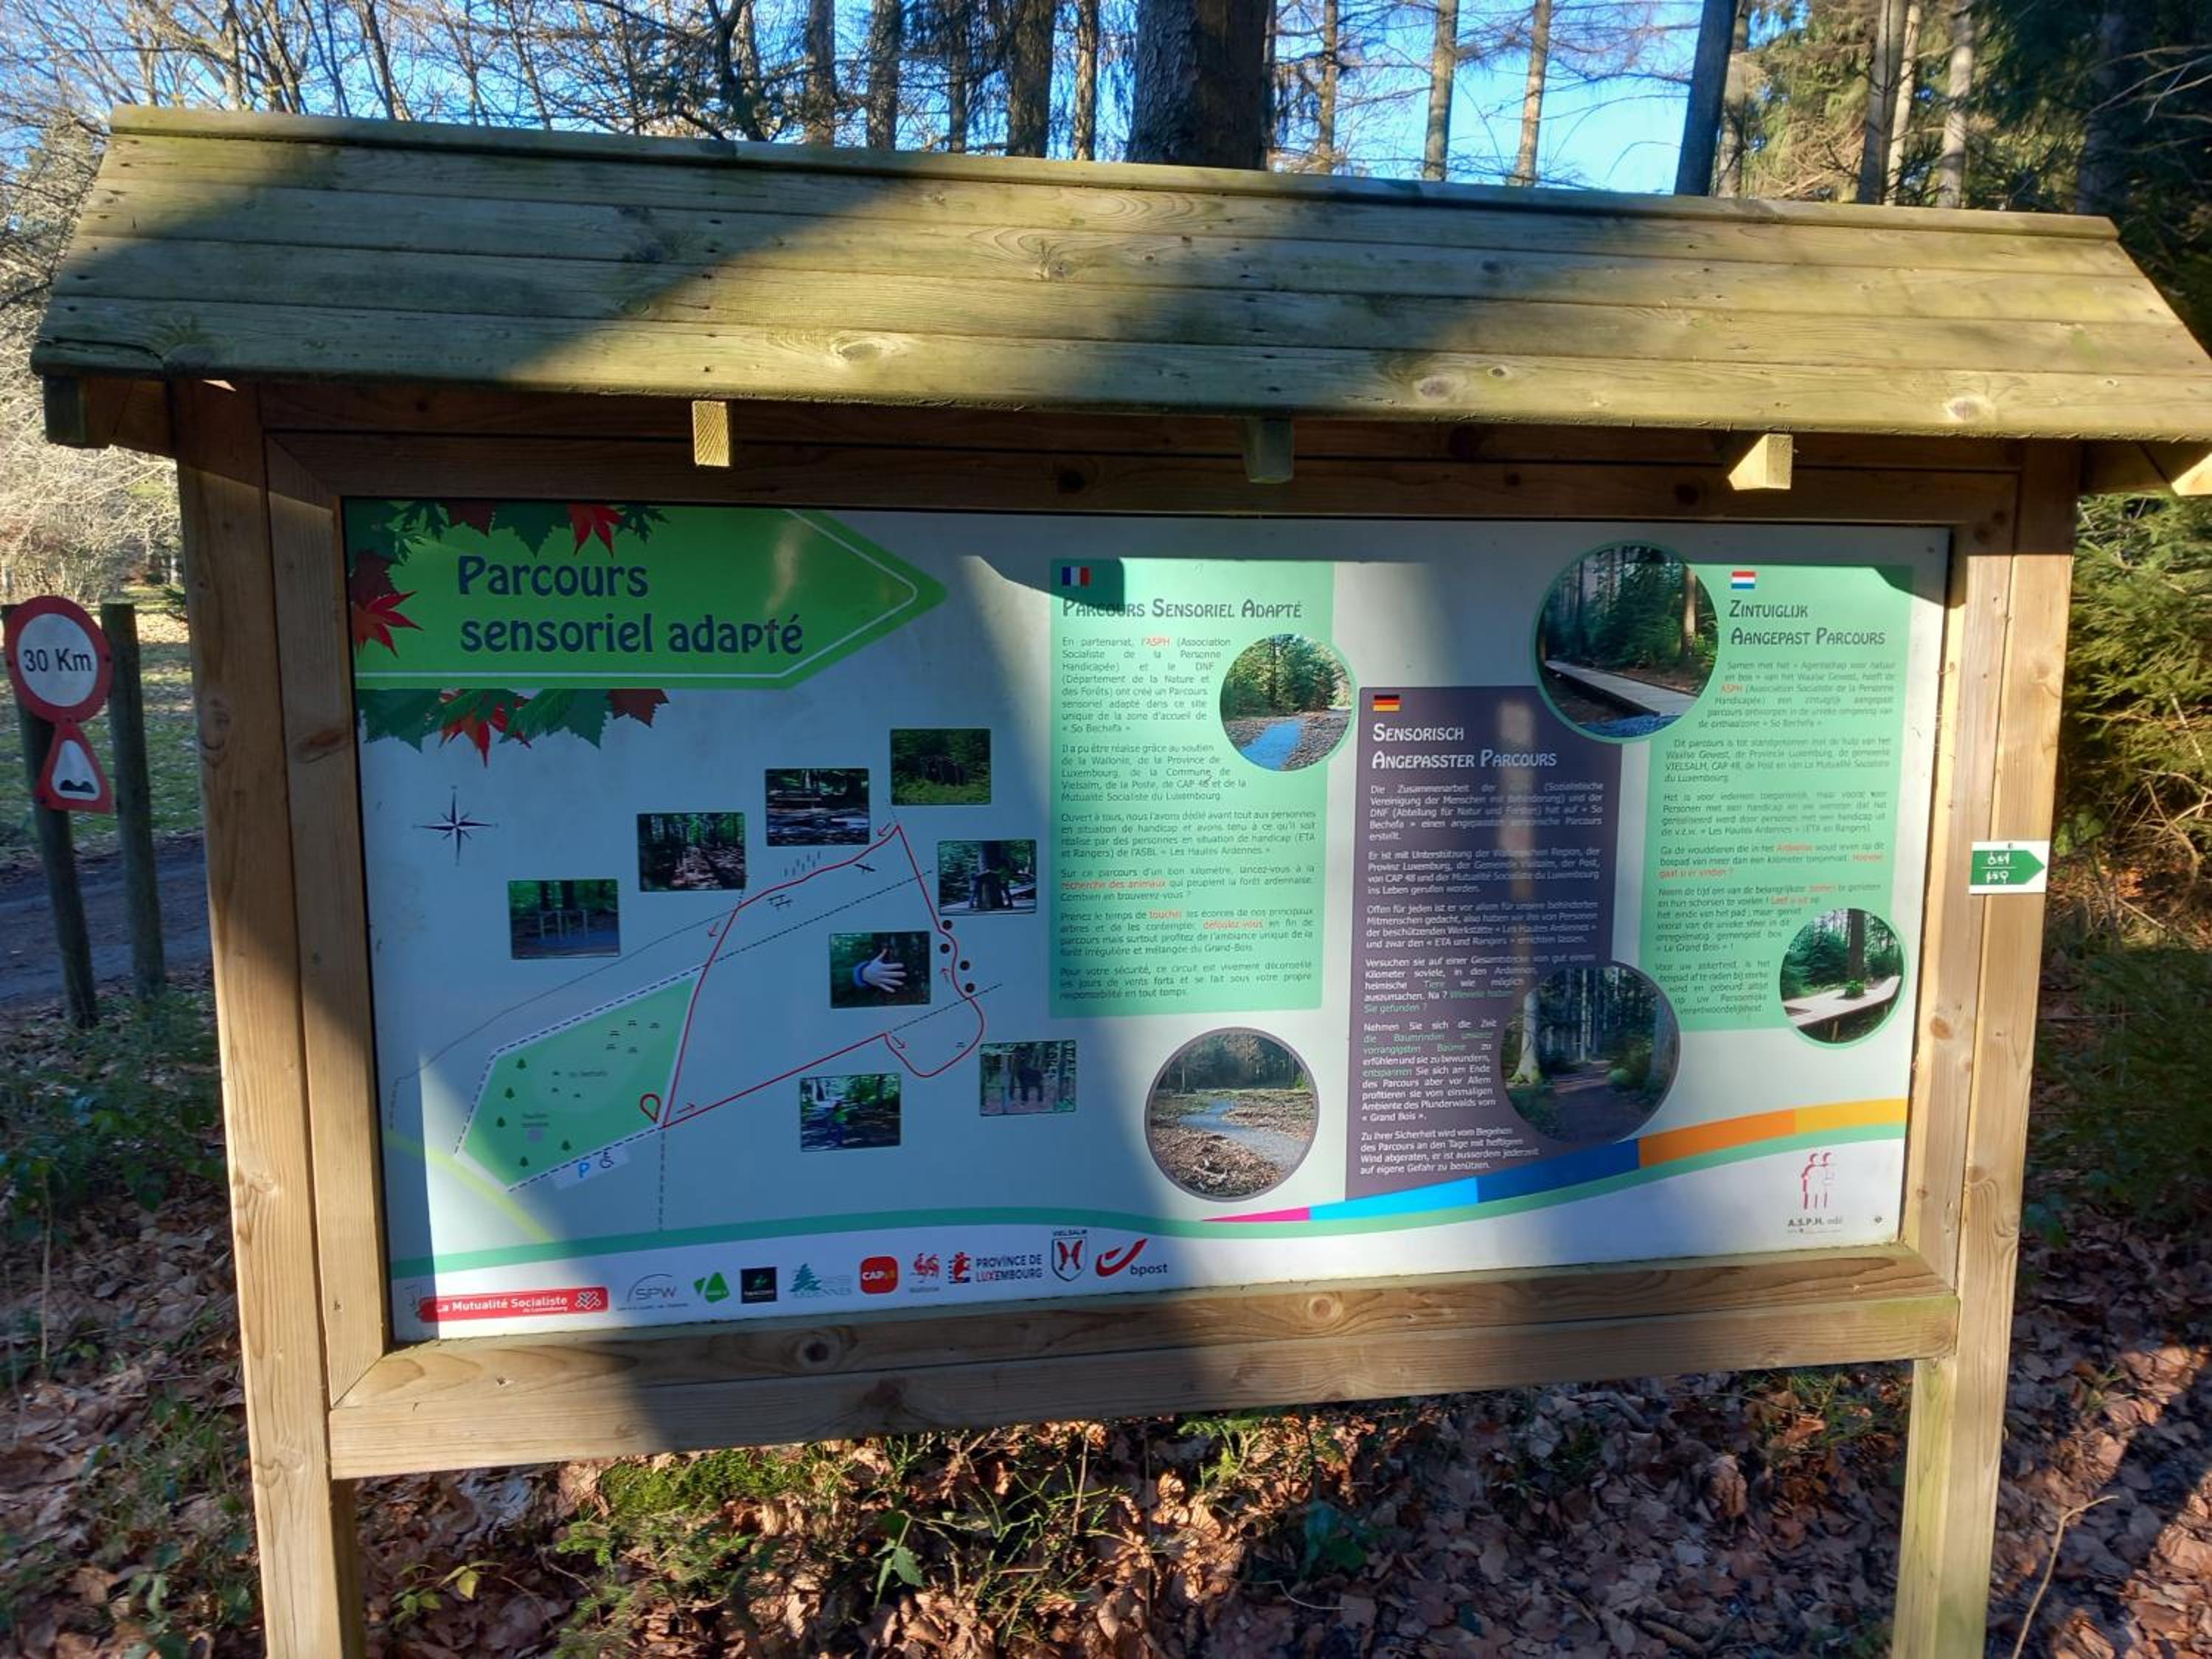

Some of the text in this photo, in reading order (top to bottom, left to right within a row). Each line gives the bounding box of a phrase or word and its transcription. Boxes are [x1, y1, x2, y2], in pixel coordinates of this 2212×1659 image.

[458, 554, 649, 597] Parcours
[1062, 597, 1302, 619] PARCOURS SENSORIEL ADAPTÉ
[1728, 599, 1809, 619] ZINTUIGLIJK
[459, 612, 803, 655] sensoriel adapté
[1731, 627, 1887, 646] AANGEPAST PARCOURS
[1062, 637, 1074, 646] En
[23, 647, 92, 672] 30 Km
[1123, 649, 1135, 658] de
[1180, 649, 1221, 658] Personne
[1138, 662, 1148, 670] et
[1167, 662, 1175, 670] le
[1195, 662, 1214, 670] DNF
[1132, 674, 1143, 683] de
[1150, 674, 1158, 683] la
[1164, 674, 1194, 683] Nature
[1062, 686, 1078, 695] des
[1115, 686, 1130, 695] ont
[1169, 686, 1208, 695] Parcours
[1146, 699, 1168, 708] dans
[1062, 712, 1093, 722] unique
[1097, 712, 1109, 720] de
[1114, 712, 1121, 720] la
[1195, 711, 1206, 720] de
[1372, 723, 1464, 742] SENSORISCH
[1077, 745, 1089, 754] pu
[1371, 749, 1557, 769] ANGEPASSTER PARCOURS
[1105, 780, 1116, 789] de
[1211, 779, 1221, 787] et
[1222, 779, 1234, 787] de
[1238, 778, 1246, 787] la
[1107, 792, 1148, 801] Socialiste
[1126, 933, 1158, 942] surtout
[1196, 932, 1208, 941] de
[1292, 929, 1302, 938] de
[1399, 1055, 1415, 1064] und
[1416, 1054, 1427, 1063] sie
[1362, 1079, 1377, 1088] des
[1382, 1077, 1419, 1087] Parcours
[1425, 1077, 1443, 1085] aber
[1467, 1074, 1491, 1084] Allem
[1409, 1088, 1422, 1097] sie
[1403, 1099, 1419, 1108] des
[1370, 1112, 1395, 1121] Grand
[1361, 1131, 1371, 1140] Zu
[1360, 1143, 1376, 1152] des
[1378, 1141, 1414, 1151] Parcours
[1430, 1140, 1445, 1149] den
[1360, 1153, 1382, 1163] Wind
[1444, 1150, 1454, 1159] ist
[578, 1161, 591, 1178] P
[1360, 1165, 1374, 1174] auf
[1788, 1217, 1824, 1227] A.S.P.H.
[975, 1254, 1042, 1268] PROVINCE DE
[975, 1267, 1042, 1282] LUXEMBOURG
[1130, 1263, 1168, 1276] bpost
[635, 1286, 677, 1300] SPW
[452, 1298, 508, 1311] Mutualité
[510, 1295, 567, 1308] Socialiste
